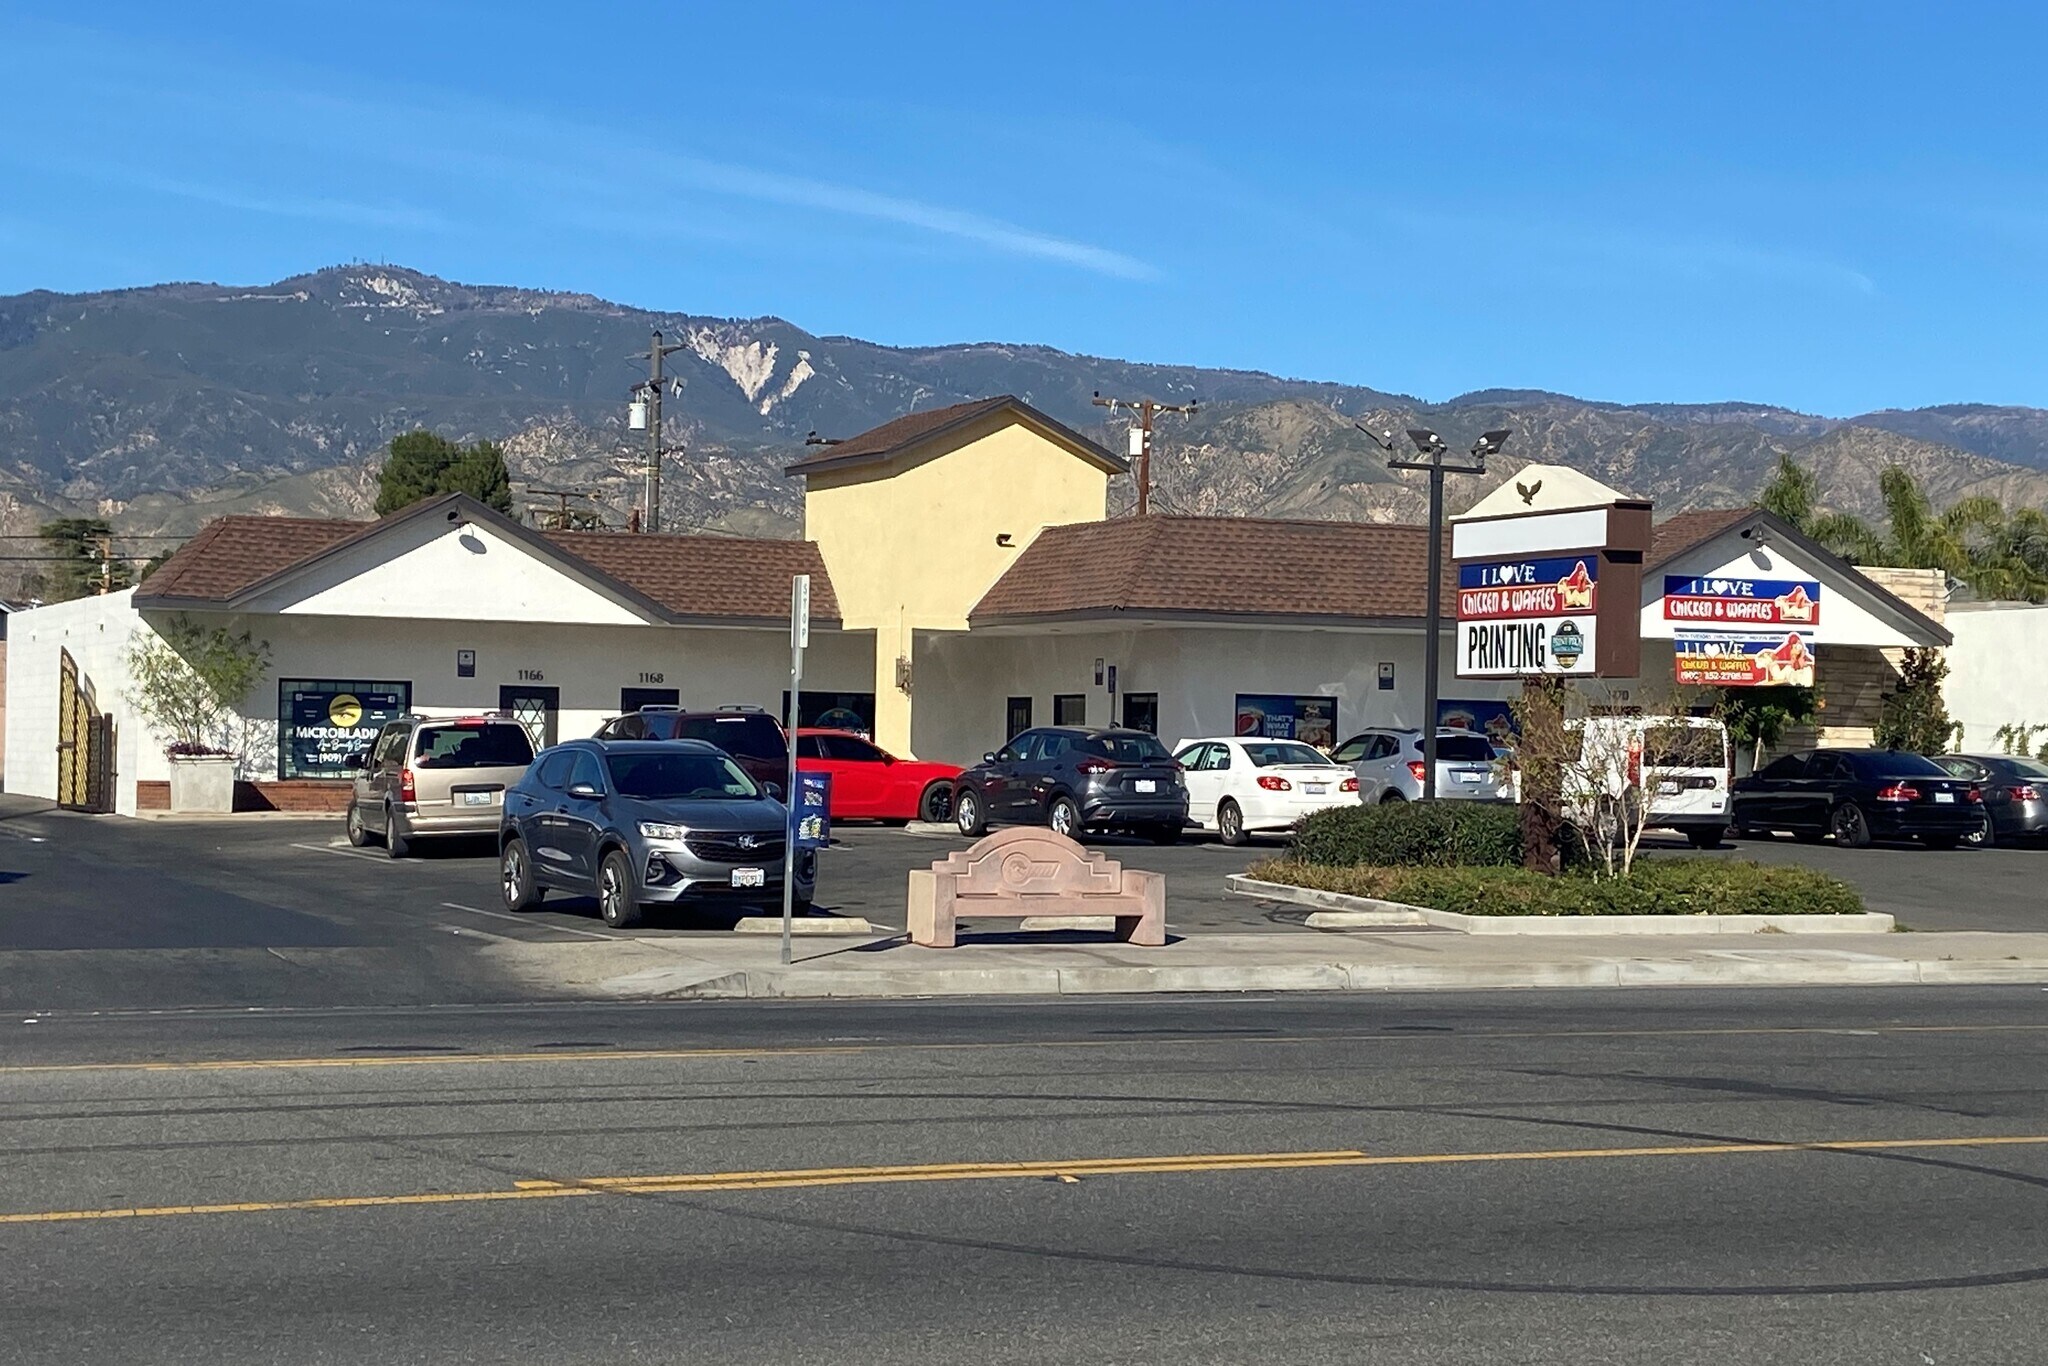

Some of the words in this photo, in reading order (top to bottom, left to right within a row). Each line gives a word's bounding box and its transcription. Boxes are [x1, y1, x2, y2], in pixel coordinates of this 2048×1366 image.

[1481, 568, 1488, 585] I
[1690, 580, 1698, 593] I
[1501, 591, 1510, 612] &
[1714, 601, 1724, 616] &
[1468, 622, 1546, 669] PRINTING
[1684, 642, 1690, 659] I
[518, 669, 544, 681] 1166
[638, 672, 664, 684] 1168
[1266, 722, 1290, 730] WHAT
